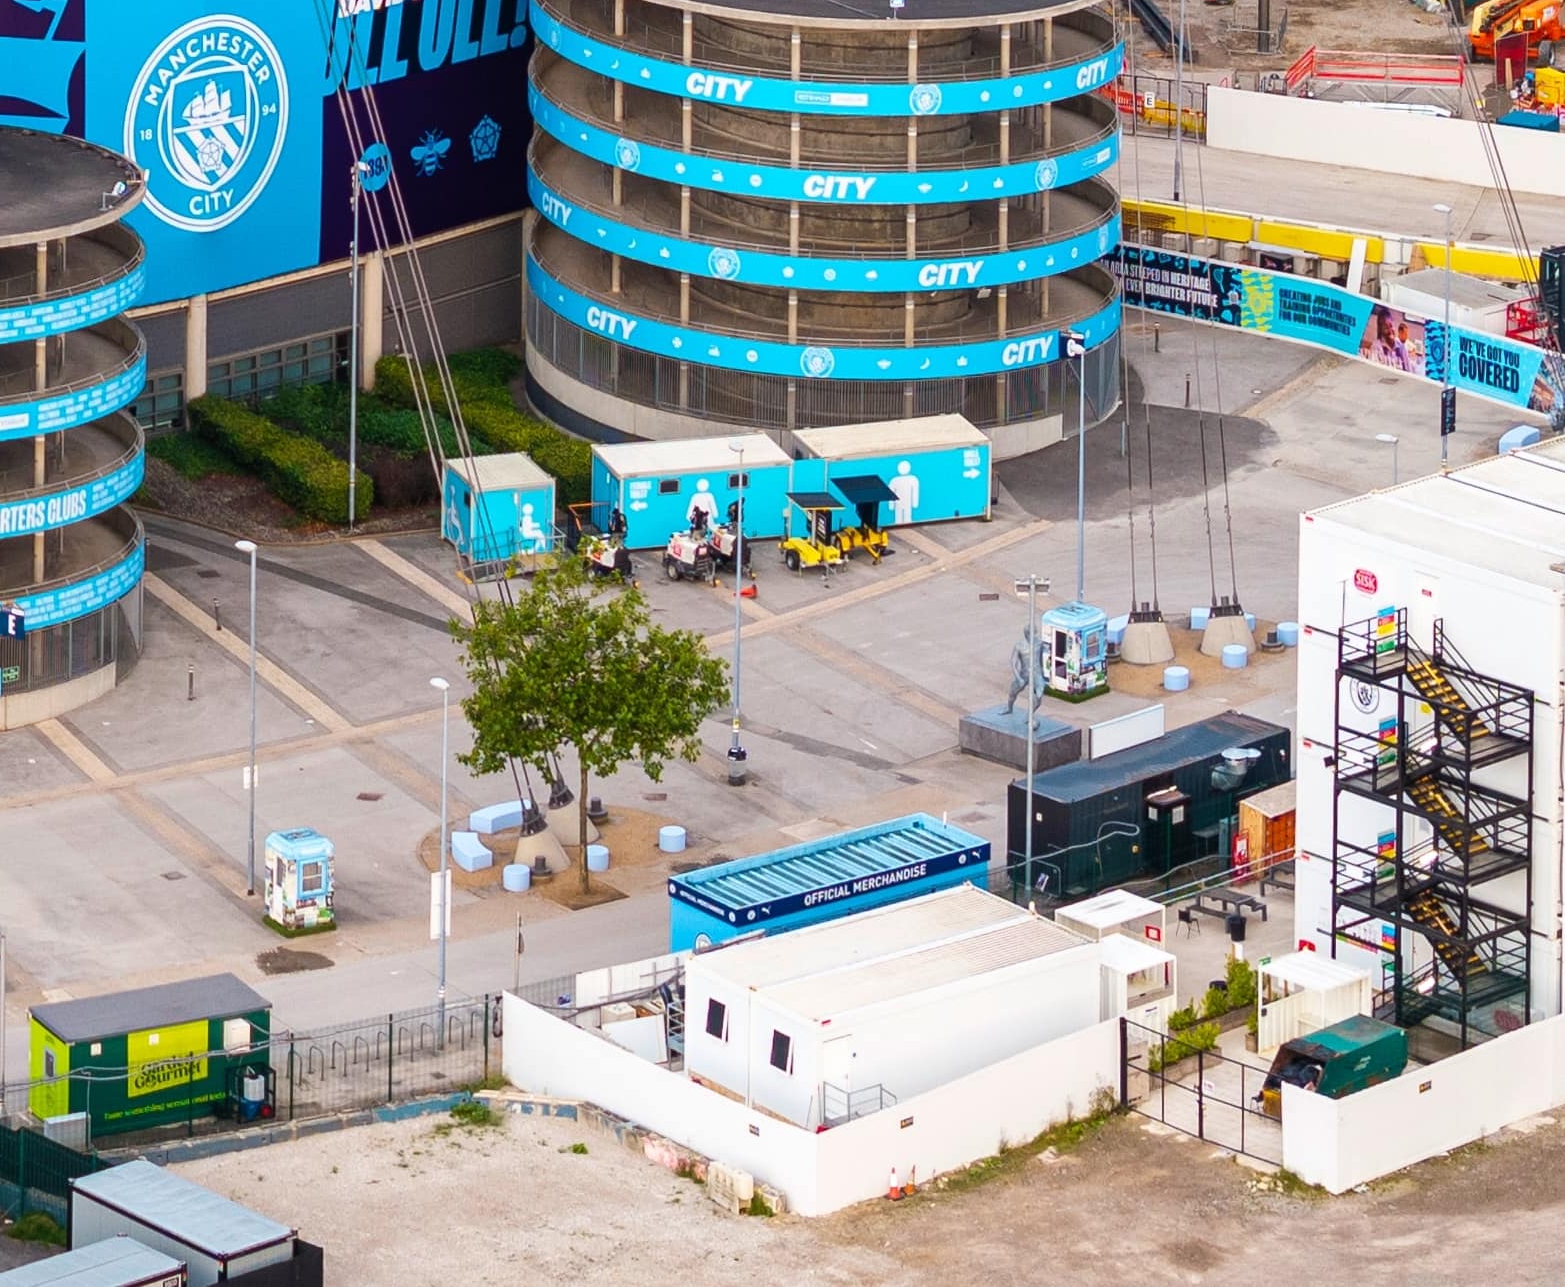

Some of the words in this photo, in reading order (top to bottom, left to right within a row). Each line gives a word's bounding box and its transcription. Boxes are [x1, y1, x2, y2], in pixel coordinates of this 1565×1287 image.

[143, 32, 271, 108] MANCHESTER
[1075, 60, 1108, 89] CITY
[685, 73, 753, 103] CITY
[1146, 97, 1153, 106] E
[262, 104, 277, 116] 94
[139, 129, 153, 142] 18
[190, 189, 234, 216] CITY
[804, 175, 877, 201] CITY
[541, 192, 572, 226] CITY
[918, 261, 984, 287] CITY
[1145, 282, 1186, 301] BRIGHTER
[585, 306, 637, 341] CITY
[1002, 336, 1054, 366] CITY
[1459, 336, 1486, 358] WE'VE
[1487, 345, 1502, 362] GOT
[1503, 350, 1520, 368] YOU
[1459, 353, 1520, 394] COVERED
[47, 489, 87, 523] CLUBS
[8, 614, 16, 635] E
[804, 884, 850, 906] OFFICIAL
[853, 864, 927, 894] MERCHANDISE
